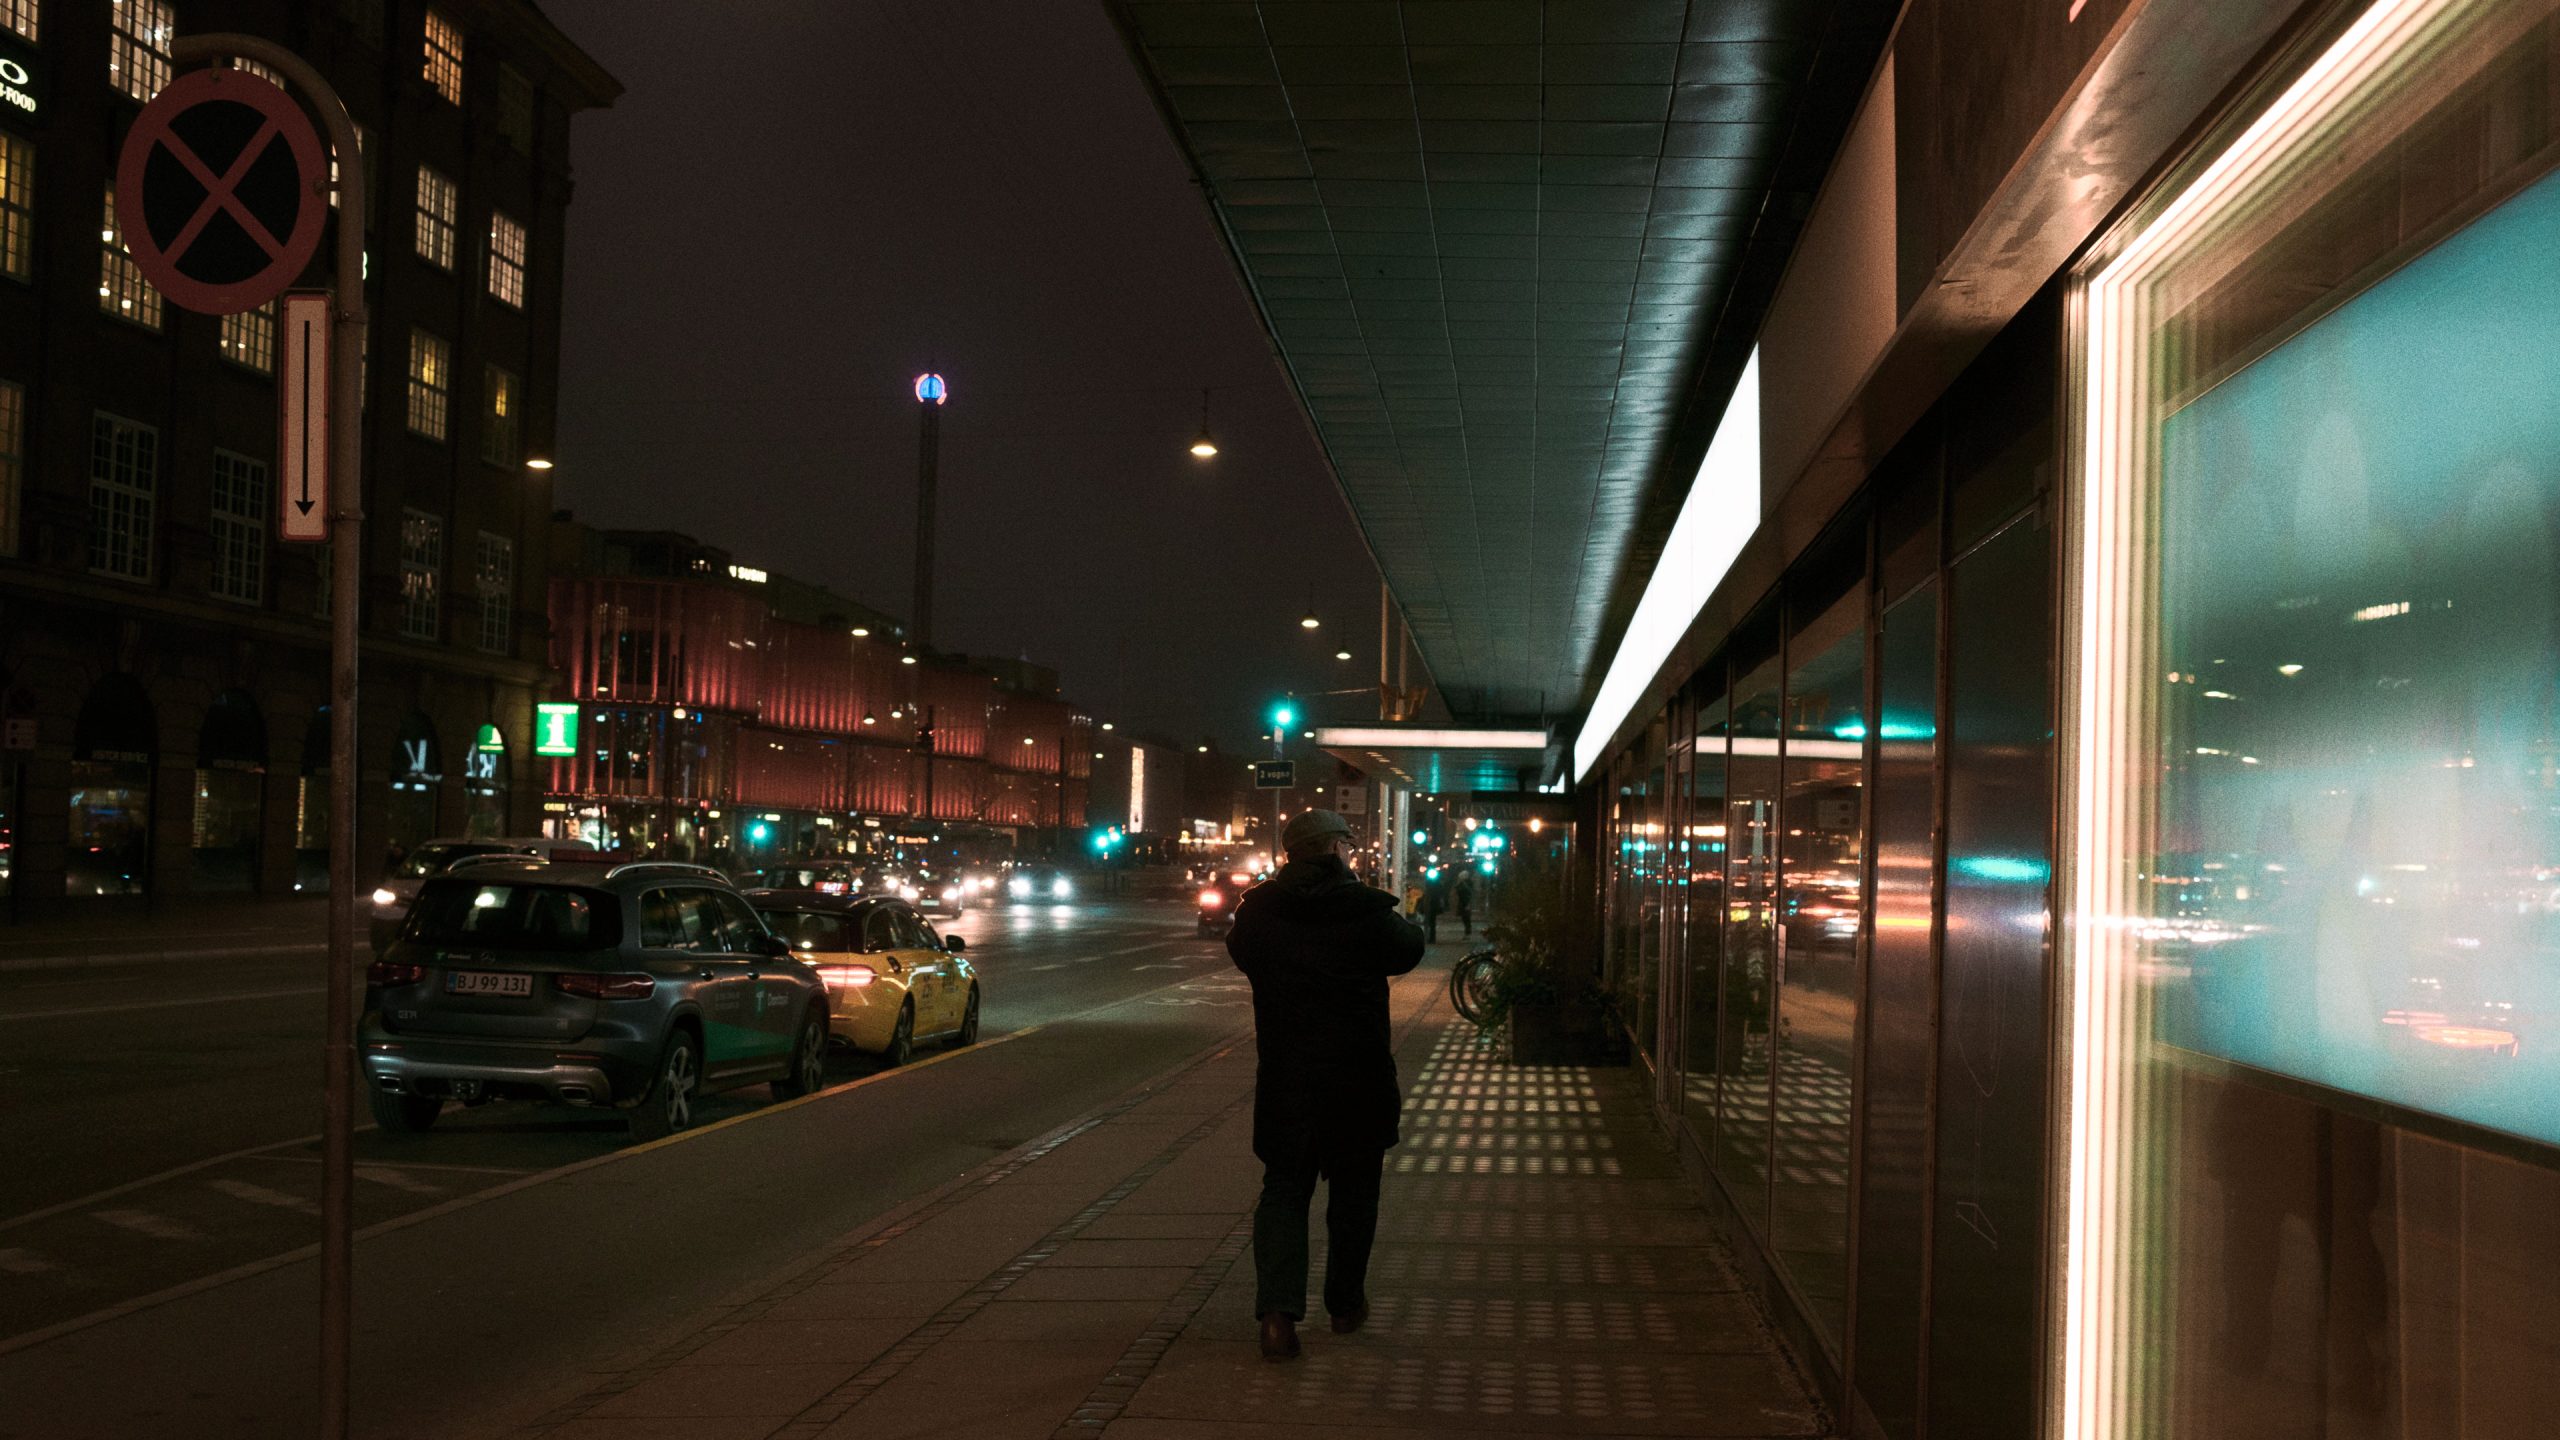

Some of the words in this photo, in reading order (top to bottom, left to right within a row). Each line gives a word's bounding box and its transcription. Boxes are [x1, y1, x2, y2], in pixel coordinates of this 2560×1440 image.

[458, 975, 476, 989] BJ
[481, 976, 498, 991] 99
[503, 977, 526, 992] 131
